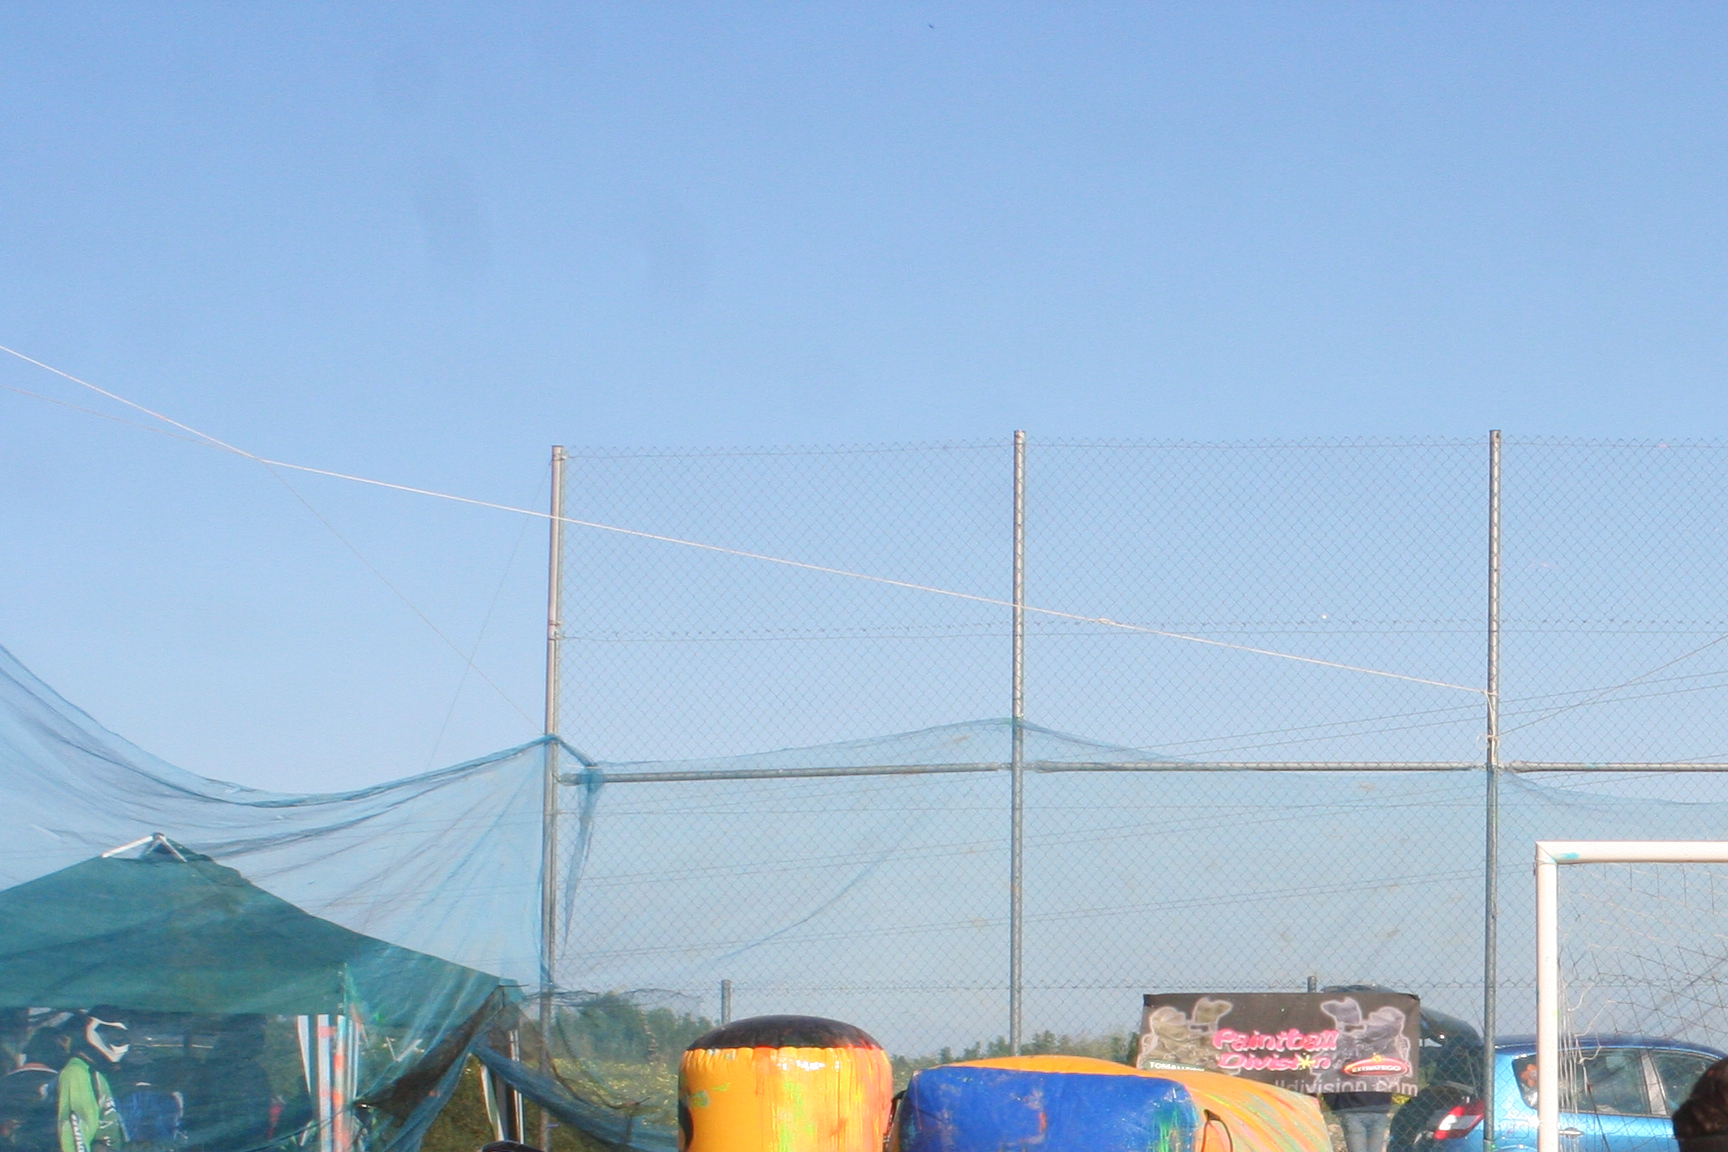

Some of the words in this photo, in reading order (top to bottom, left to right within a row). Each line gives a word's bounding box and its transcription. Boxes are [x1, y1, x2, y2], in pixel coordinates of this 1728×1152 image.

[1212, 1028, 1340, 1052] Paintball
[1149, 1061, 1205, 1072] TOMA
[1217, 1052, 1332, 1071] Divisin
